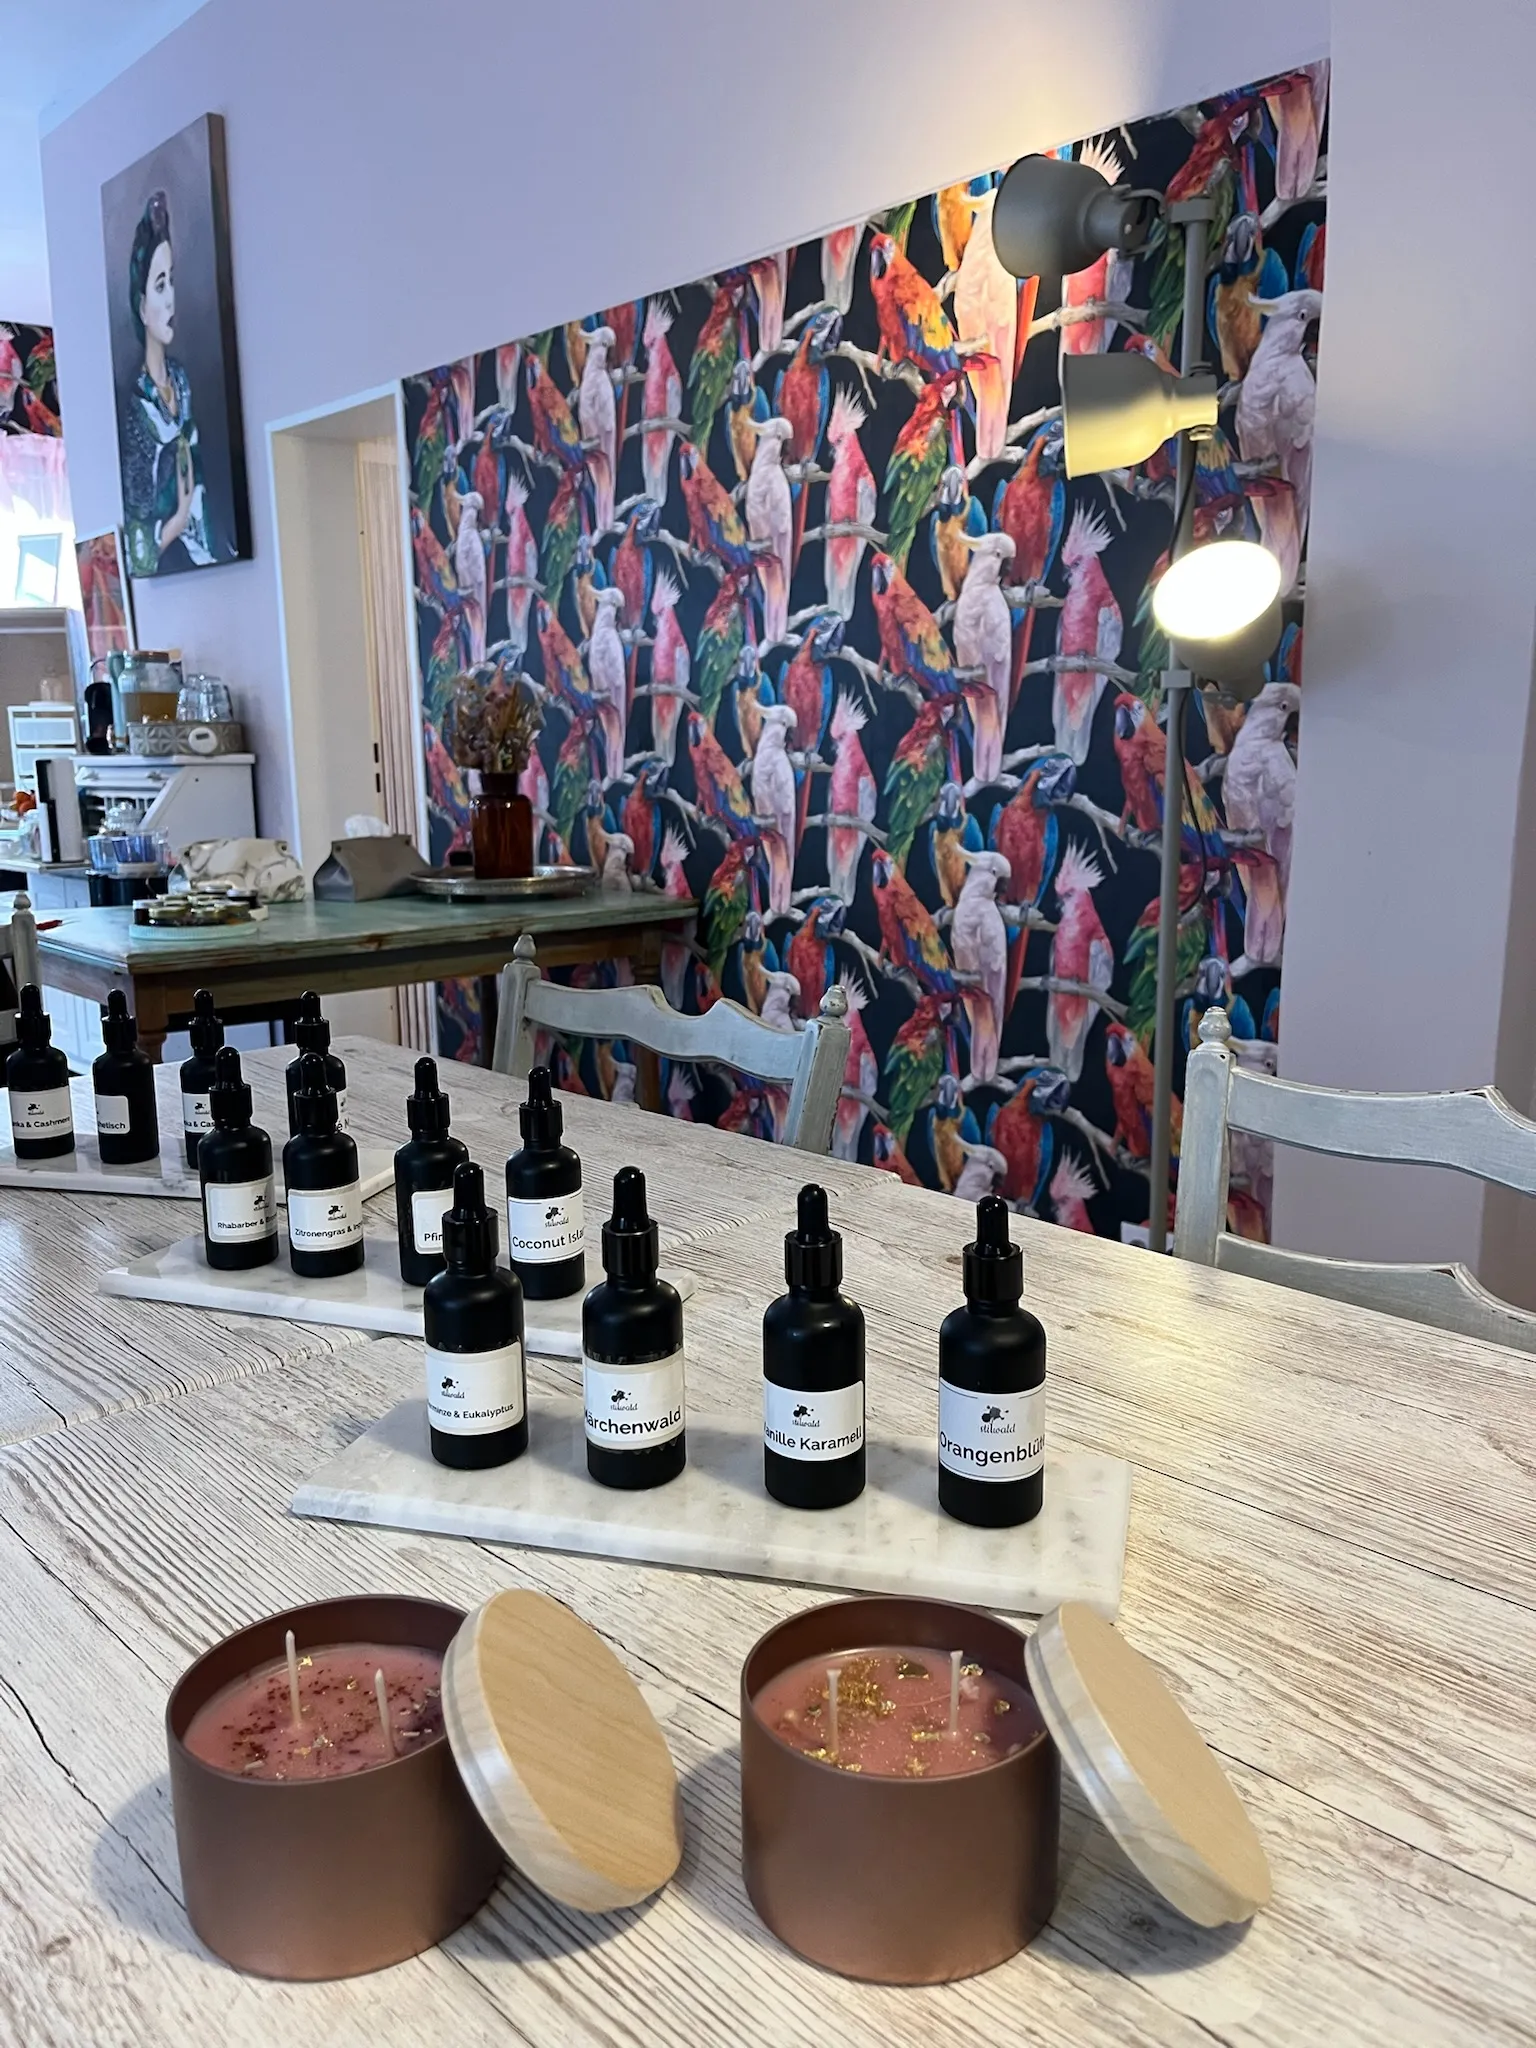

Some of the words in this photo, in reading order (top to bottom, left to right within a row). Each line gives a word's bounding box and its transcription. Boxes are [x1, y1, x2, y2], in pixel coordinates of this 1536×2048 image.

[217, 1220, 258, 1229] Rhabarber
[295, 1228, 346, 1238] Zitronengras
[512, 1235, 566, 1249] Coconut
[453, 1410, 460, 1419] &
[463, 1403, 514, 1419] Eukalyptus
[800, 1425, 862, 1451] Karamell
